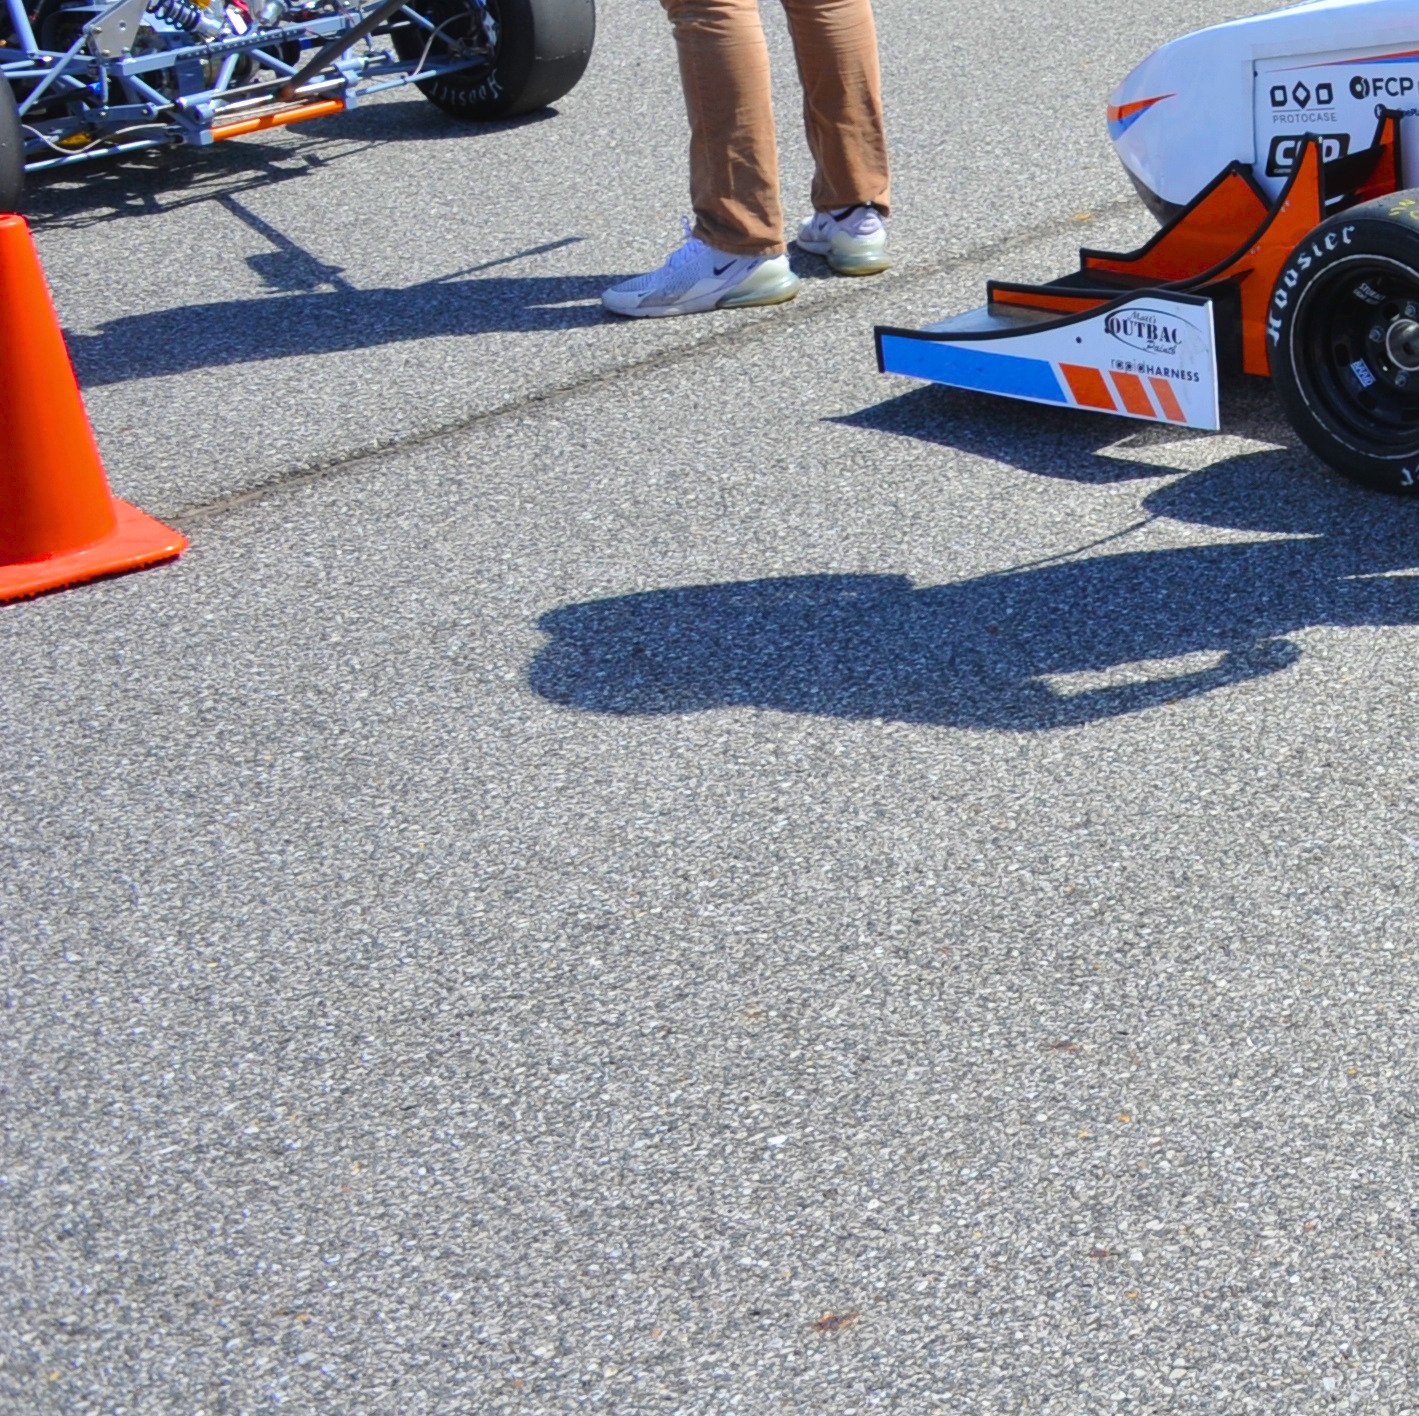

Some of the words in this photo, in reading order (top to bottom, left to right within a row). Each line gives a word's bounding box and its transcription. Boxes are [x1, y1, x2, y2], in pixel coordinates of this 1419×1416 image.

[1373, 77, 1414, 97] FCP
[1273, 113, 1338, 124] PROTOCASE
[1267, 225, 1355, 347] Hoosier
[1111, 359, 1200, 382] rapidHARNESS
